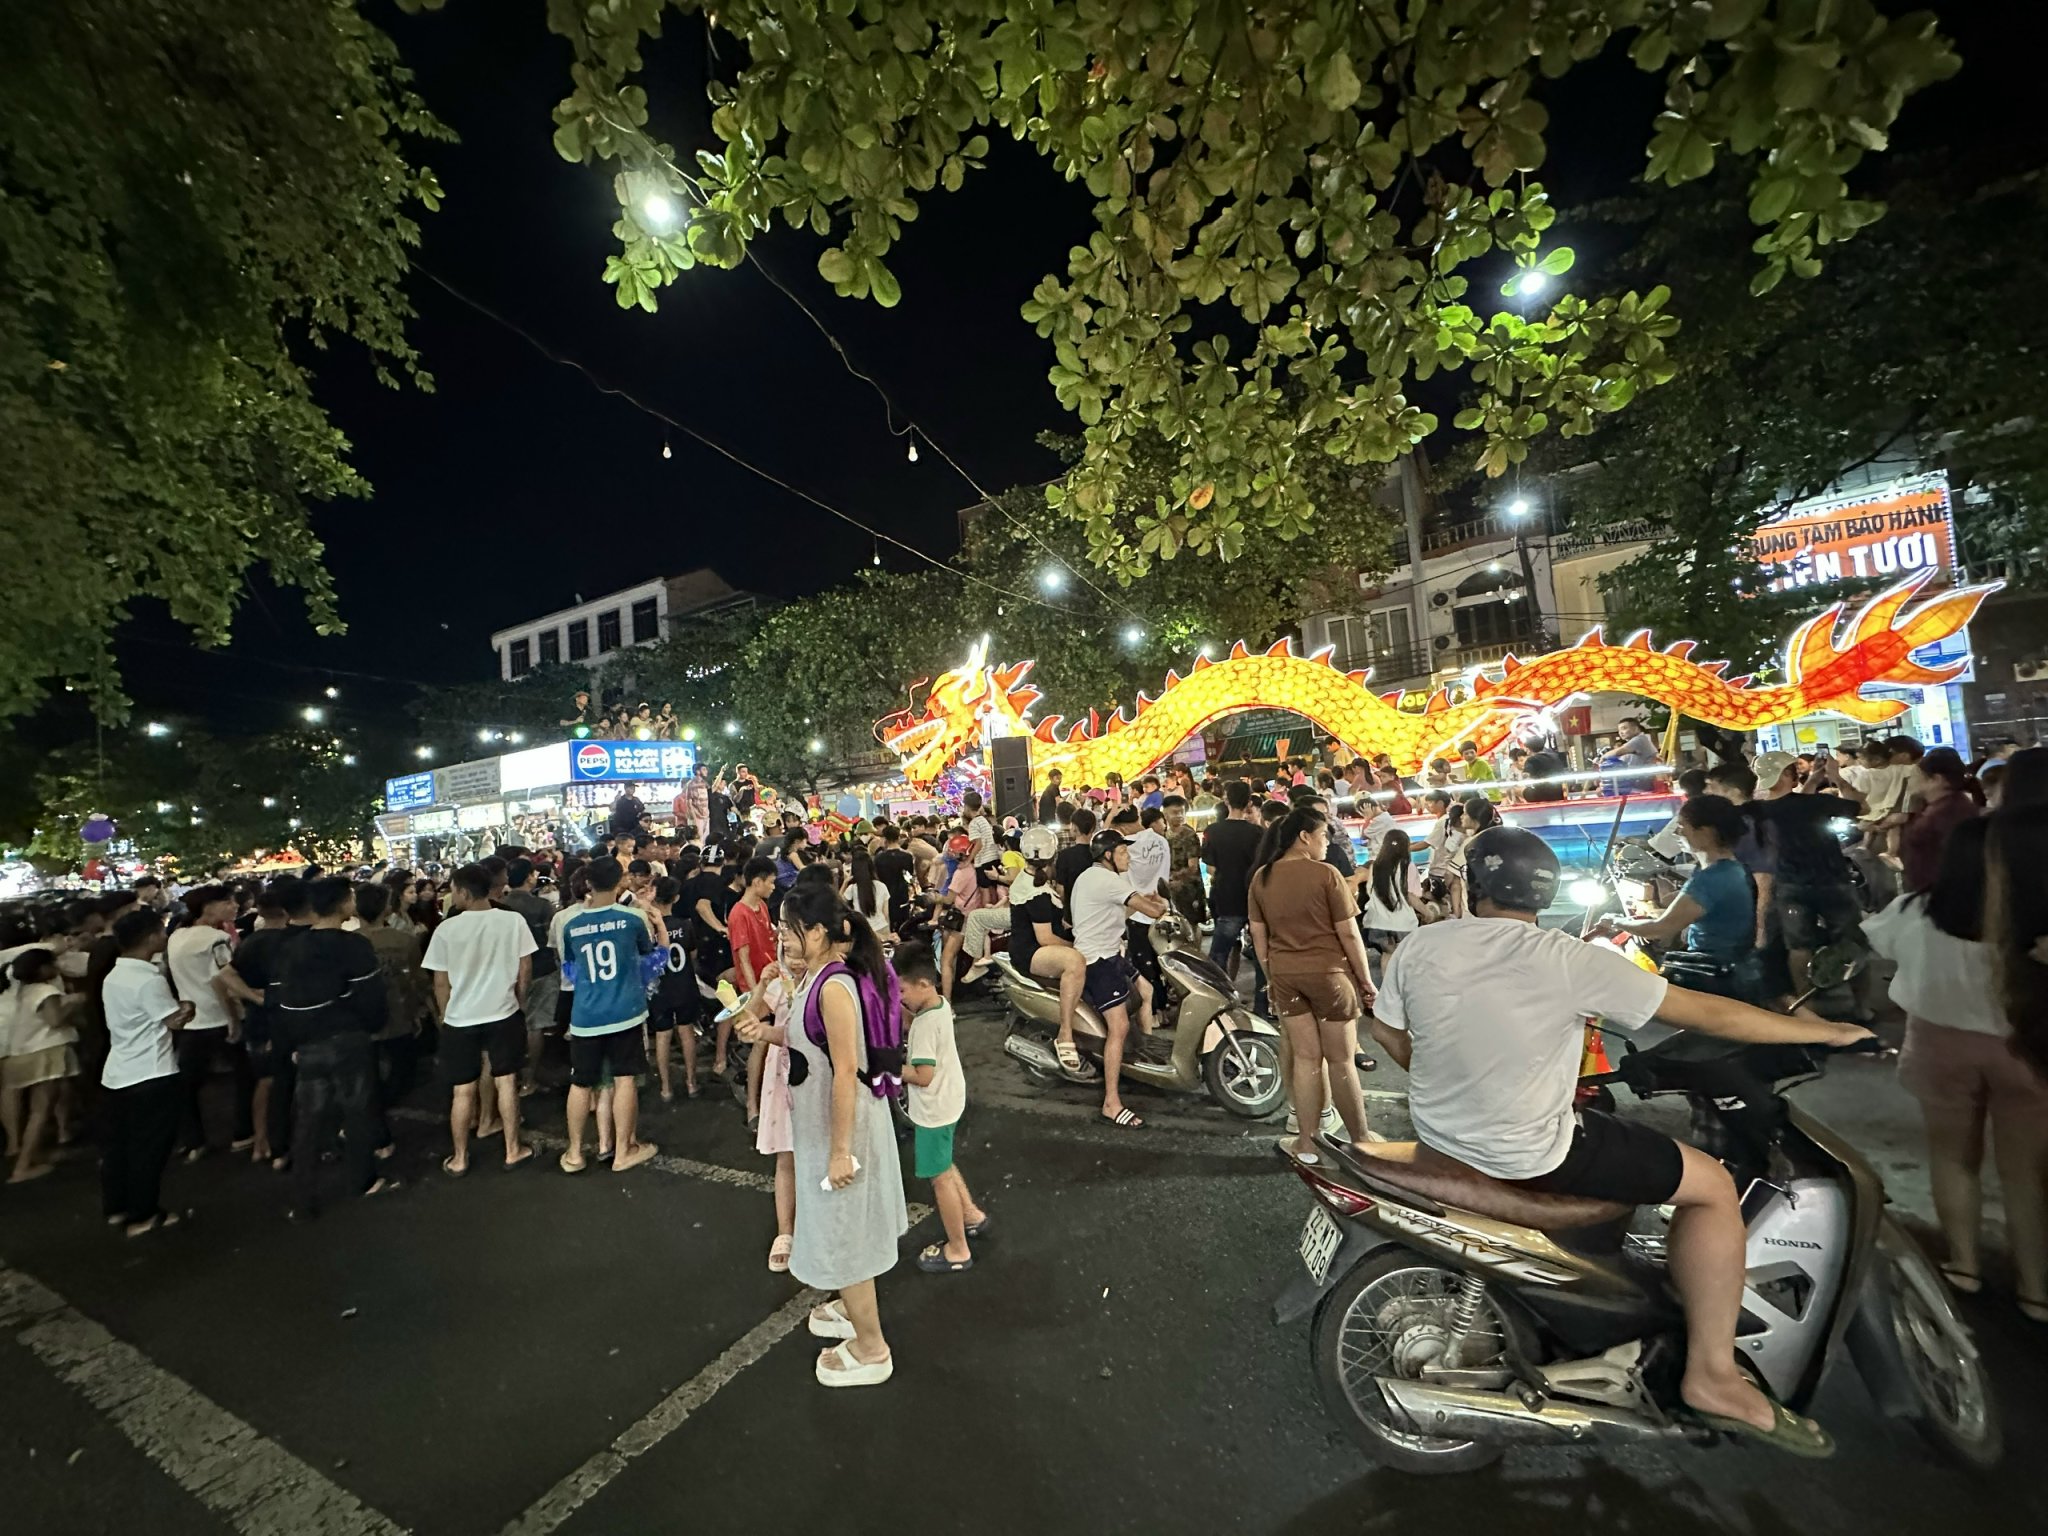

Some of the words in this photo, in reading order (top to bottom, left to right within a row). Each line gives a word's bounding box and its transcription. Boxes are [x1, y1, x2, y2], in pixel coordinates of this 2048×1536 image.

[1751, 531, 1798, 556] RUNG
[1845, 510, 1885, 539] BẢO
[1848, 532, 1939, 577] TƯƠI
[579, 756, 608, 766] PEPSI
[616, 919, 627, 930] FC
[580, 940, 617, 984] 19
[1763, 1237, 1823, 1250] HONDA
